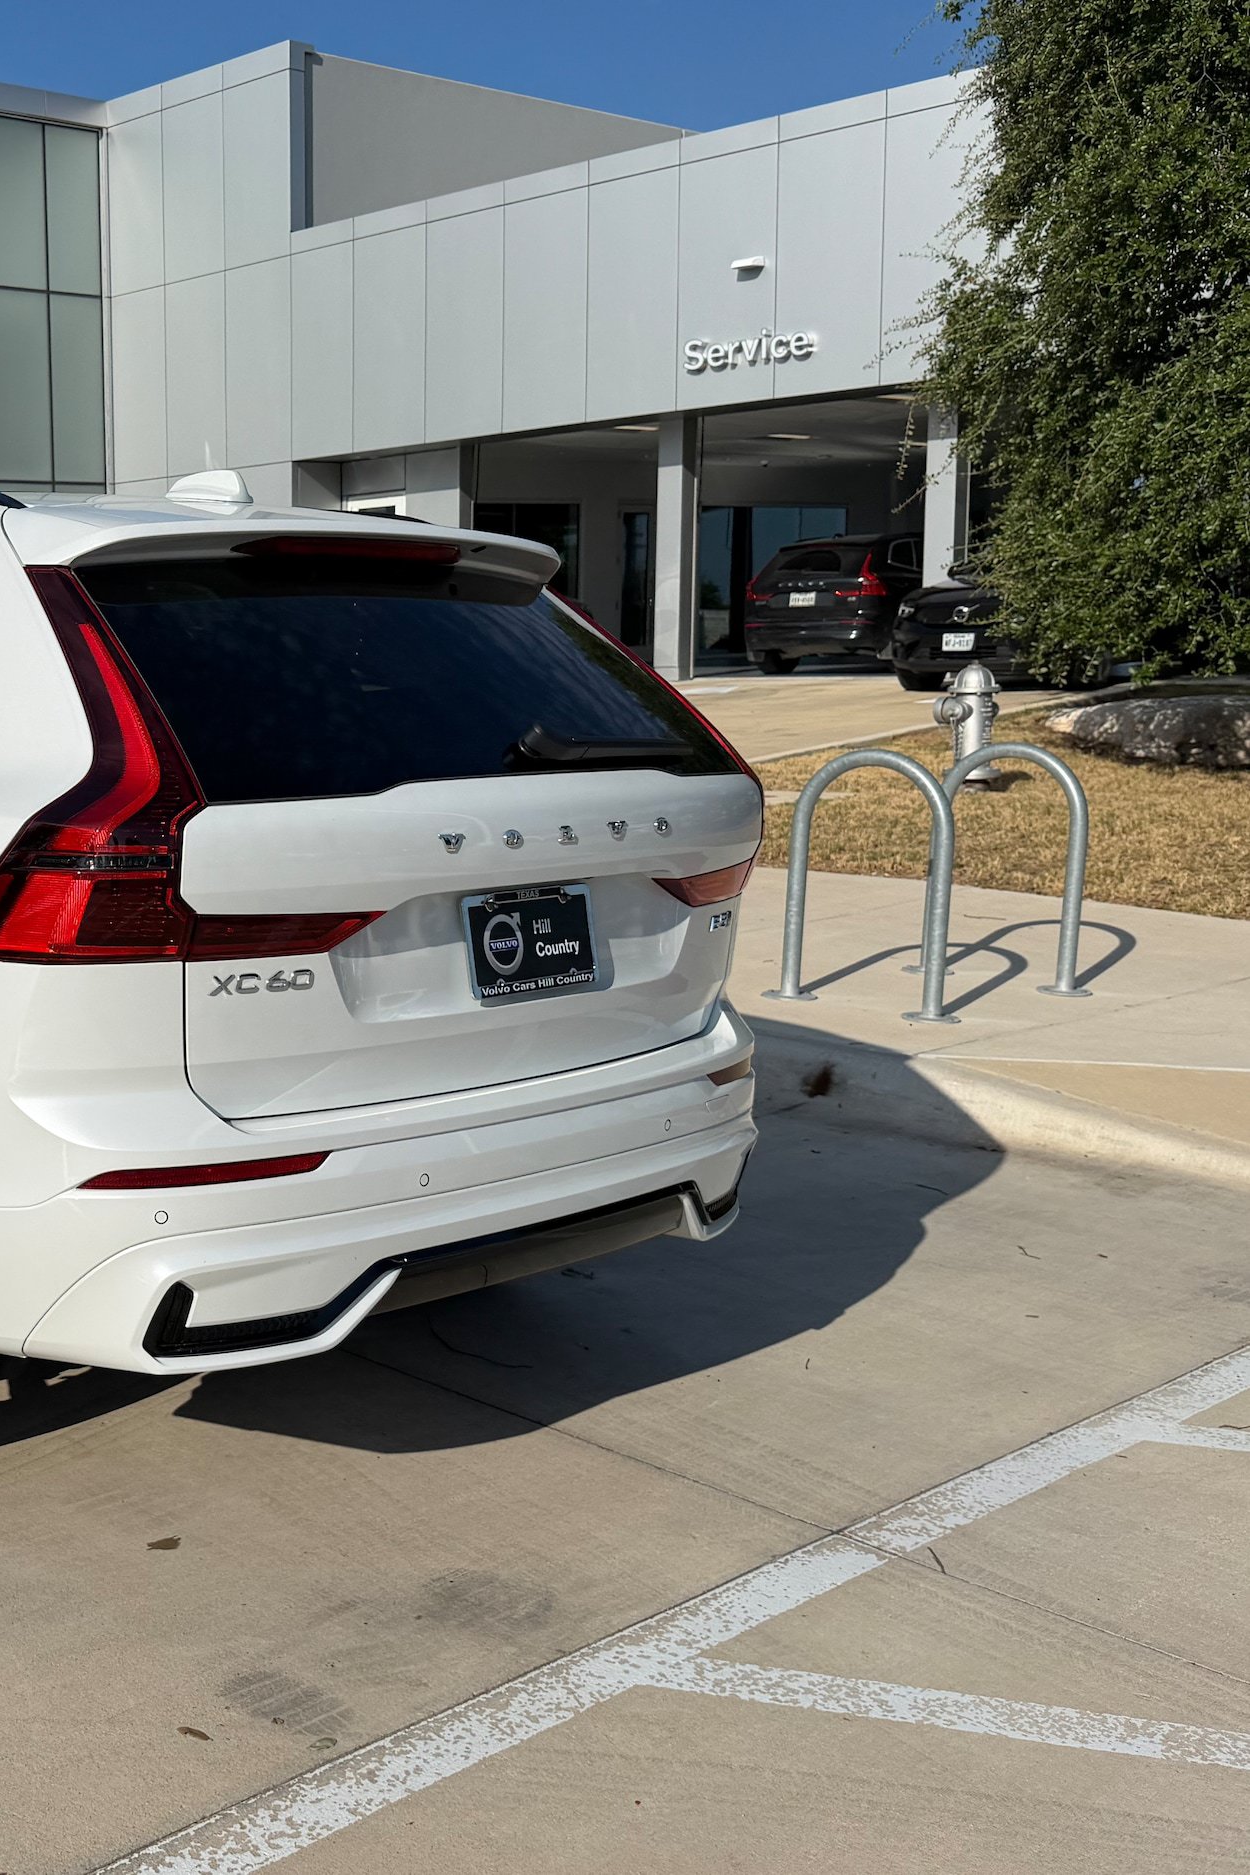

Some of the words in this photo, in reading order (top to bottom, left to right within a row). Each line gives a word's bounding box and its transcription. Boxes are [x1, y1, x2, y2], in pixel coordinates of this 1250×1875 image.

[683, 328, 811, 371] Service
[438, 816, 672, 854] VOLVO
[516, 889, 540, 900] TEXAS
[532, 917, 552, 935] Hill
[489, 938, 518, 950] VOLVO
[535, 938, 580, 958] Country
[208, 968, 315, 997] XC60
[482, 984, 510, 998] Volvo
[512, 981, 536, 992] Cars
[538, 976, 555, 988] Hill
[556, 972, 594, 986] Country
